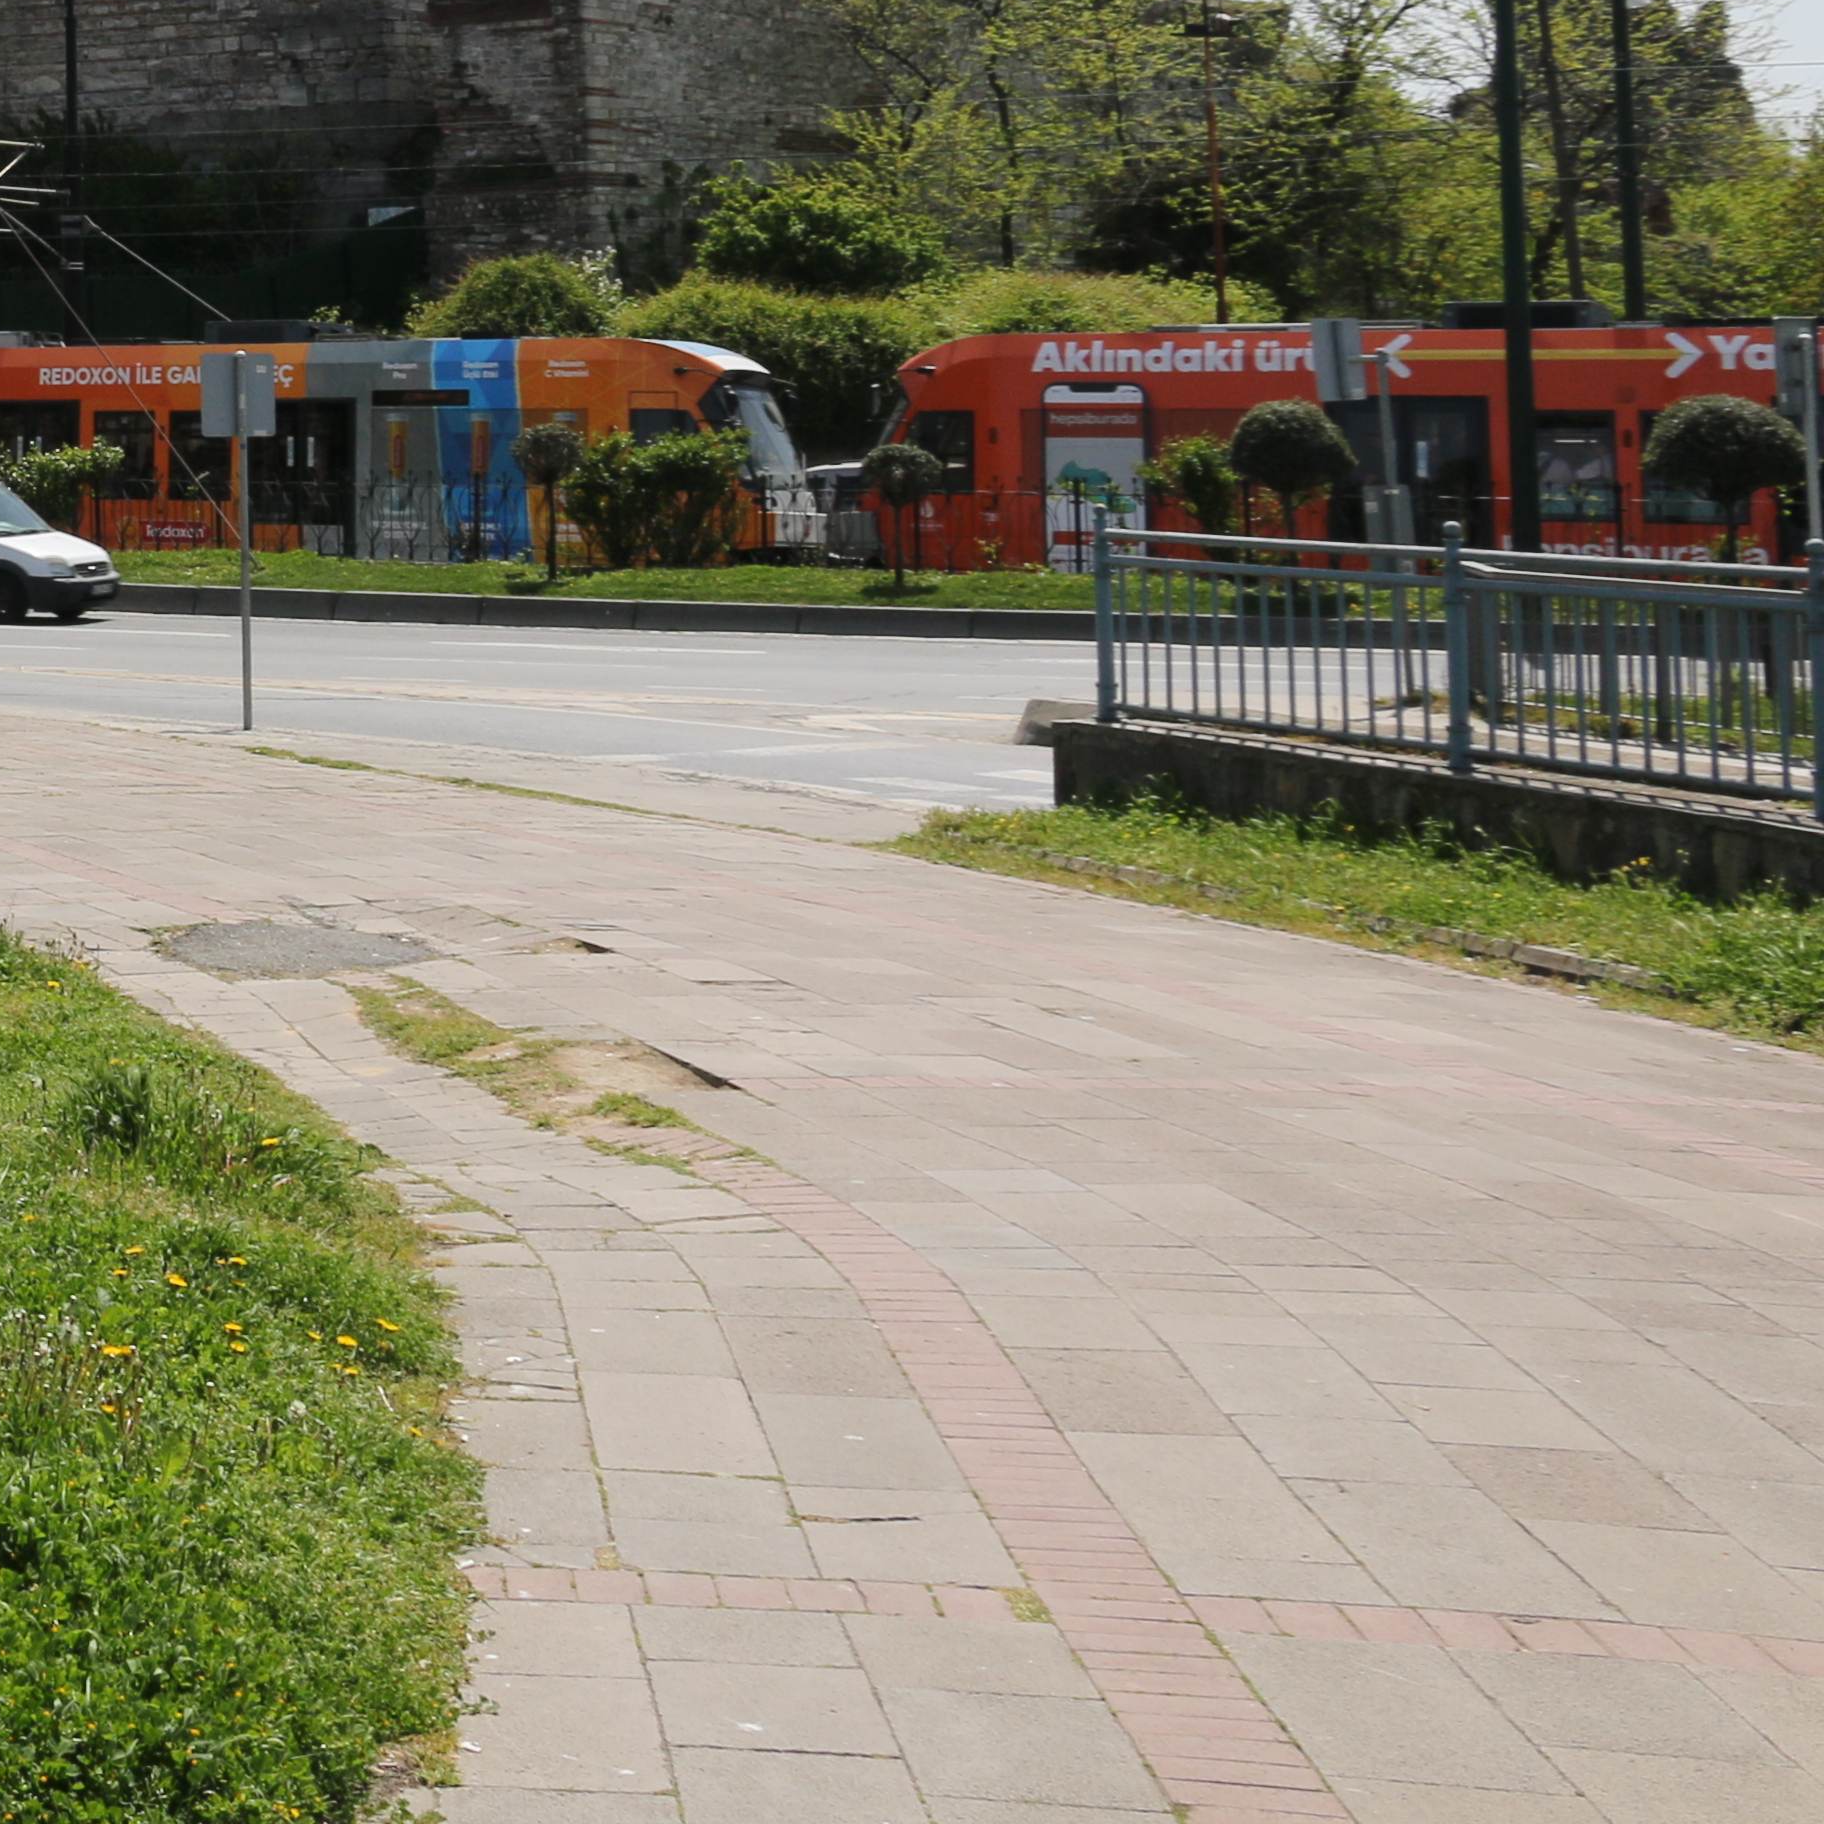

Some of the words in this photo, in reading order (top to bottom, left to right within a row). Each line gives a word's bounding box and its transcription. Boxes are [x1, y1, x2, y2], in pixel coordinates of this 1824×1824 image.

[1032, 339, 1245, 373] Aklındaki
[38, 367, 130, 385] REDOXON
[136, 363, 162, 385] İLE
